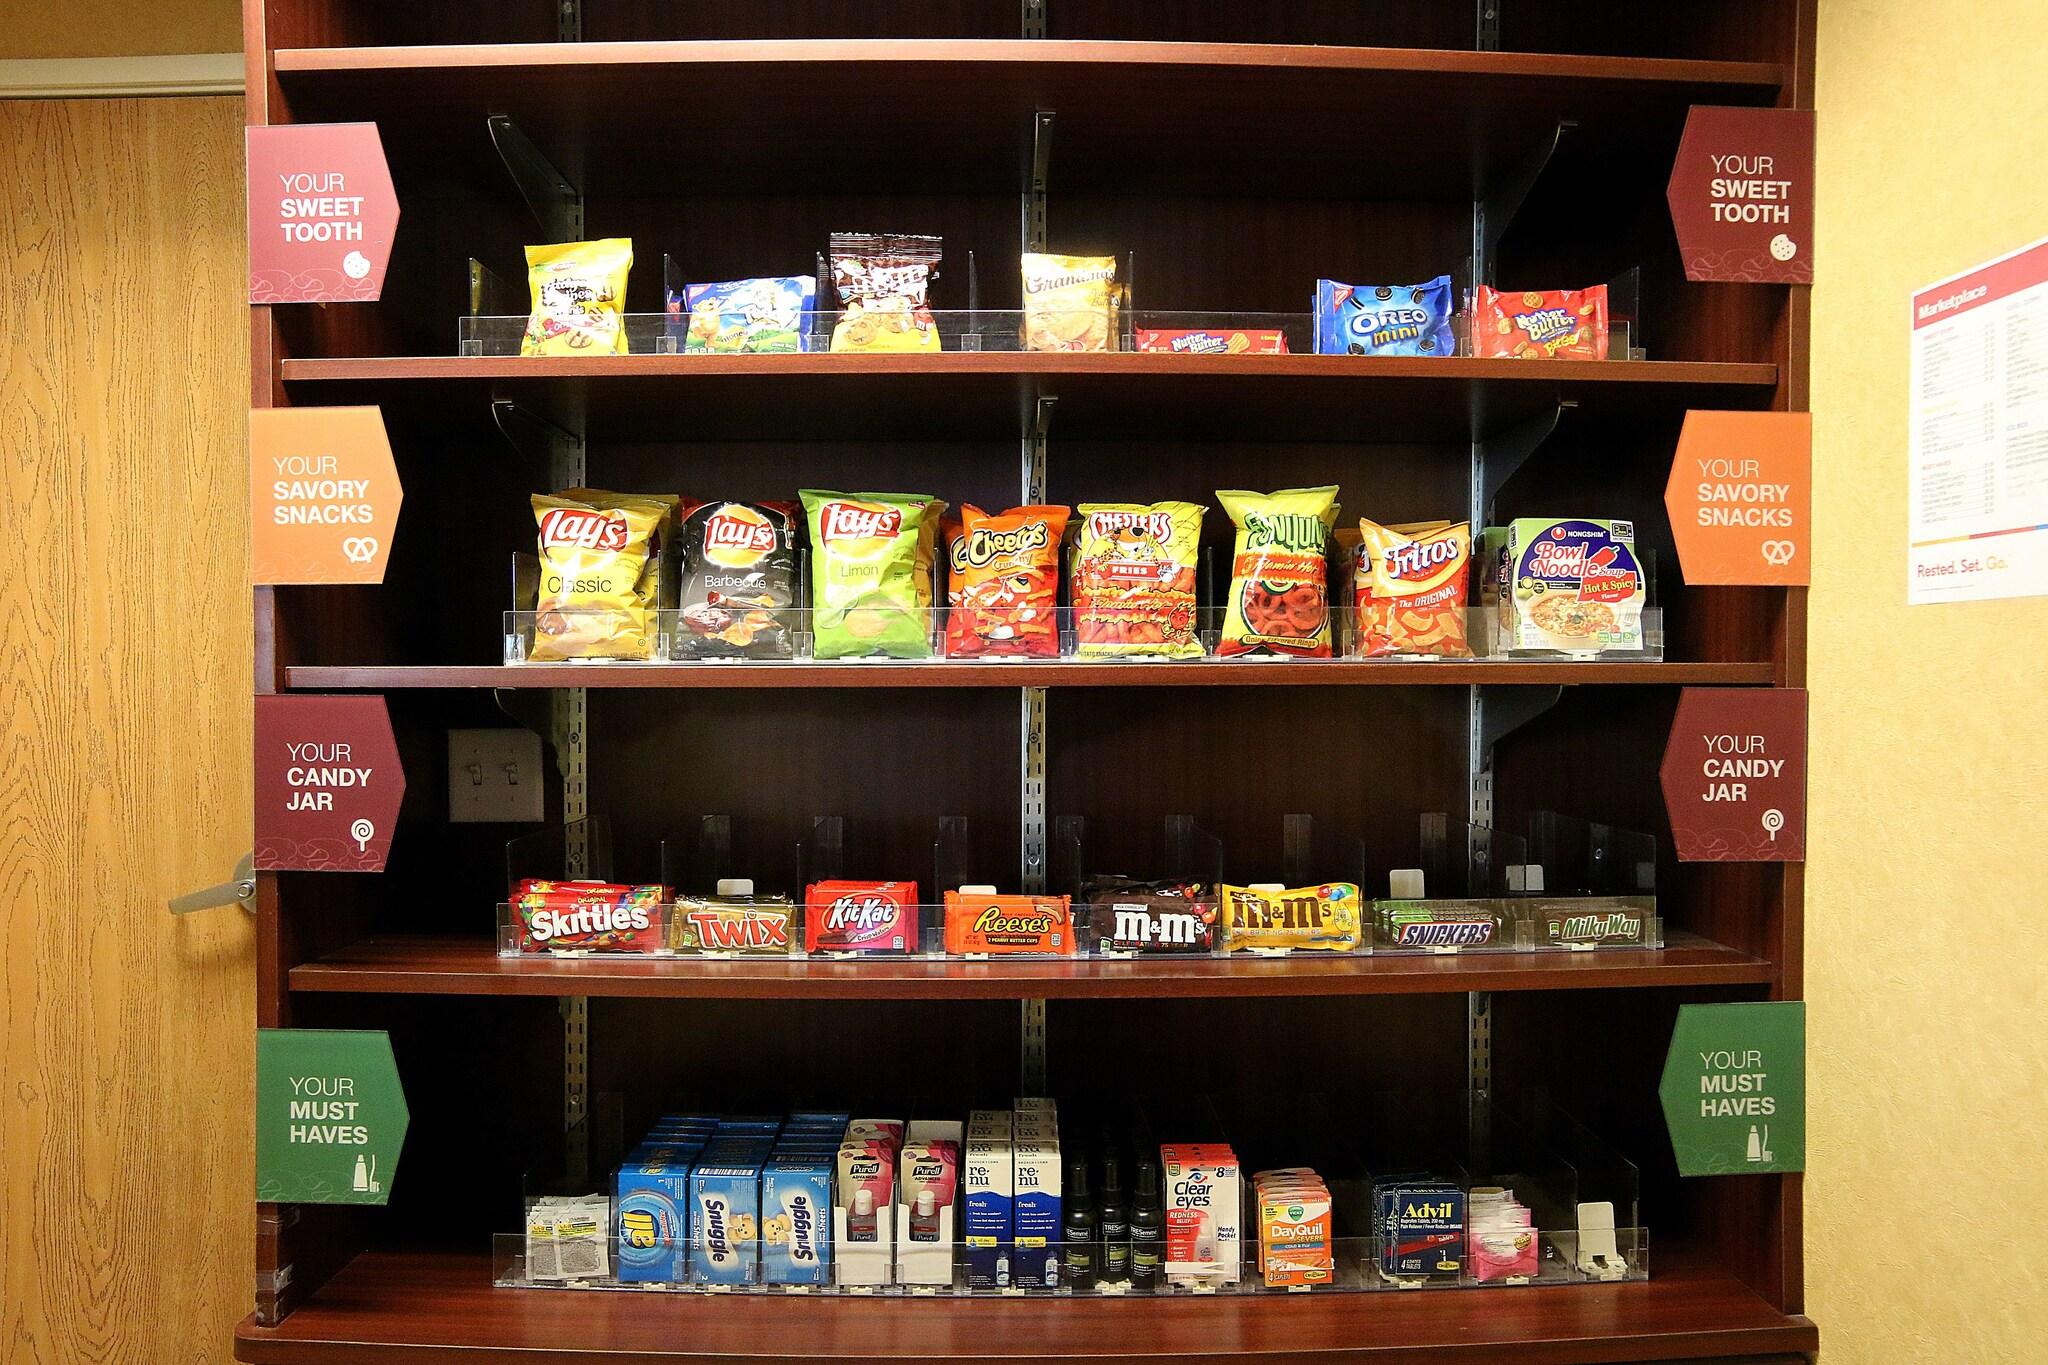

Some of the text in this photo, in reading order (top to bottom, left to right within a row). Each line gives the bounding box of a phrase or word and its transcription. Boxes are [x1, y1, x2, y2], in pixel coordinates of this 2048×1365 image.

[1711, 155, 1773, 175] YOUR
[280, 173, 345, 193] YOUR
[1711, 179, 1792, 199] SWEET
[280, 197, 364, 218] SWEET
[1710, 203, 1790, 223] TOOTH
[280, 221, 363, 242] TOOTH
[1918, 285, 1988, 320] Marketplace
[1352, 309, 1427, 335] OREO
[1528, 316, 1576, 341] Butter
[721, 329, 748, 343] Honey
[1171, 332, 1207, 351] Nutter
[1190, 336, 1224, 353] Butter
[1373, 324, 1418, 346] mini
[273, 456, 337, 475] YOUR
[1697, 459, 1760, 478] YOUR
[273, 480, 370, 500] SAVORY
[1697, 483, 1790, 503] SAVORY
[273, 505, 373, 525] SNACKS
[824, 504, 900, 540] Lay's
[1697, 508, 1793, 527] SNACKS
[544, 511, 624, 549] Lay's
[707, 517, 774, 550] Lay's
[1089, 512, 1171, 545] CHESTER'S
[1567, 530, 1604, 538] NONGSHIM
[969, 522, 1047, 566] Cheetos
[1535, 541, 1588, 560] Bowl
[1384, 538, 1458, 579] Fritos
[1531, 559, 1625, 577] Noodle Soup
[1917, 556, 2008, 578] Rested. Set. Go.
[1111, 565, 1148, 575] FRIES
[548, 576, 612, 594] Classic
[704, 573, 767, 588] Barbecue
[1584, 584, 1600, 594] Hot
[1602, 582, 1610, 591] &
[1611, 579, 1635, 591] Spicy
[1399, 600, 1412, 608] The
[1414, 585, 1458, 607] ORIGINAL
[286, 743, 351, 762] YOUR
[1703, 735, 1765, 753] YOUR
[287, 768, 372, 787] CANDY
[1703, 759, 1784, 777] CANDY
[286, 792, 333, 810] JAR
[1702, 784, 1747, 801] JAR
[531, 903, 650, 941] Skittles
[689, 909, 789, 948] Twix
[973, 905, 1053, 934] Reese's
[1402, 924, 1492, 944] SNICKERS
[1700, 1050, 1761, 1069] YOUR
[289, 1077, 354, 1096] YOUR
[1701, 1074, 1767, 1093] MUST
[290, 1101, 360, 1120] MUST
[1701, 1097, 1776, 1117] HAVES
[290, 1125, 368, 1144] HAVES
[853, 1164, 877, 1174] Purell
[916, 1166, 941, 1176] Purell
[1216, 1167, 1225, 1178] 8
[969, 1176, 990, 1186] nu
[1018, 1177, 1039, 1186] nu
[1174, 1181, 1213, 1196] Clear
[1176, 1195, 1210, 1210] eyes
[1402, 1202, 1452, 1218] Advil
[621, 1211, 656, 1248] all
[705, 1199, 730, 1262] Snuggle
[789, 1196, 814, 1261] Snuggle
[1217, 1226, 1235, 1234] Handy
[1271, 1223, 1323, 1240] DayQuil
[1401, 1259, 1406, 1269] 4
[1269, 1272, 1274, 1281] 4
